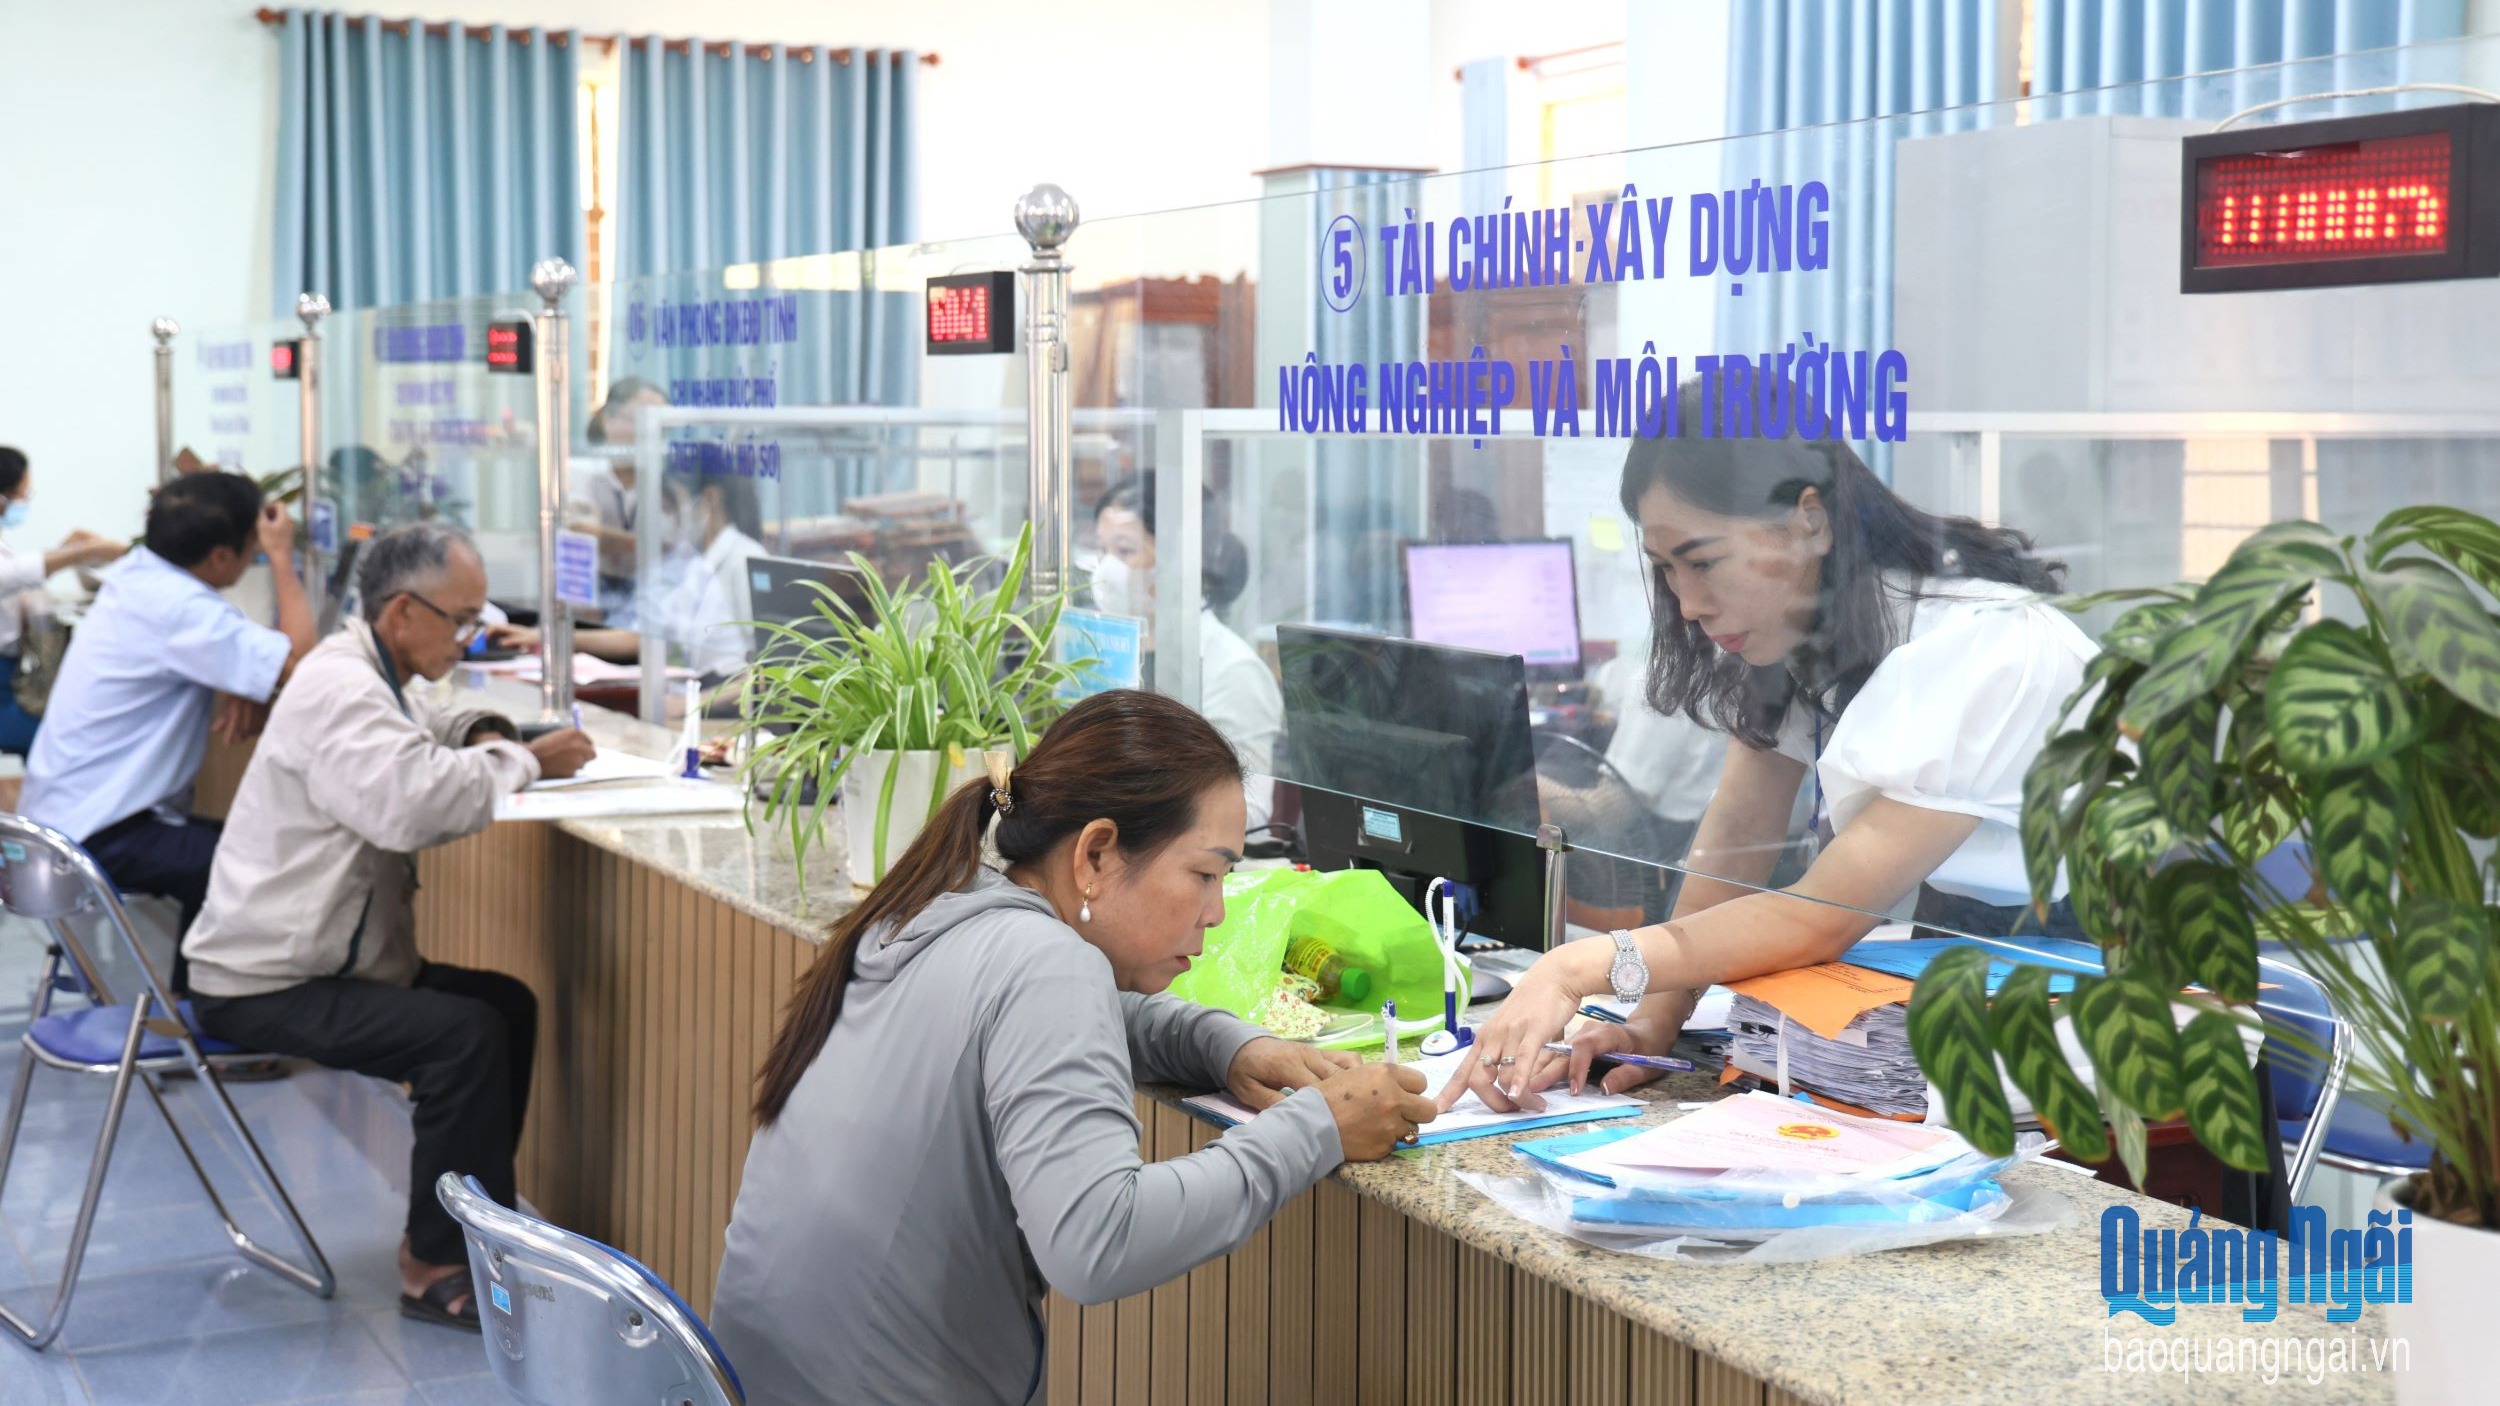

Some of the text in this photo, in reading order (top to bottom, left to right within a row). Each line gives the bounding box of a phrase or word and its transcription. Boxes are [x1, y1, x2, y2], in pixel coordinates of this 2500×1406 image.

[1333, 230, 1352, 299] 5
[1379, 208, 1435, 297] TÀI
[1690, 179, 1830, 297] DỰNG
[1279, 331, 1909, 450] NÔNG NGHIỆP VÀ MÔI TRƯỜNG
